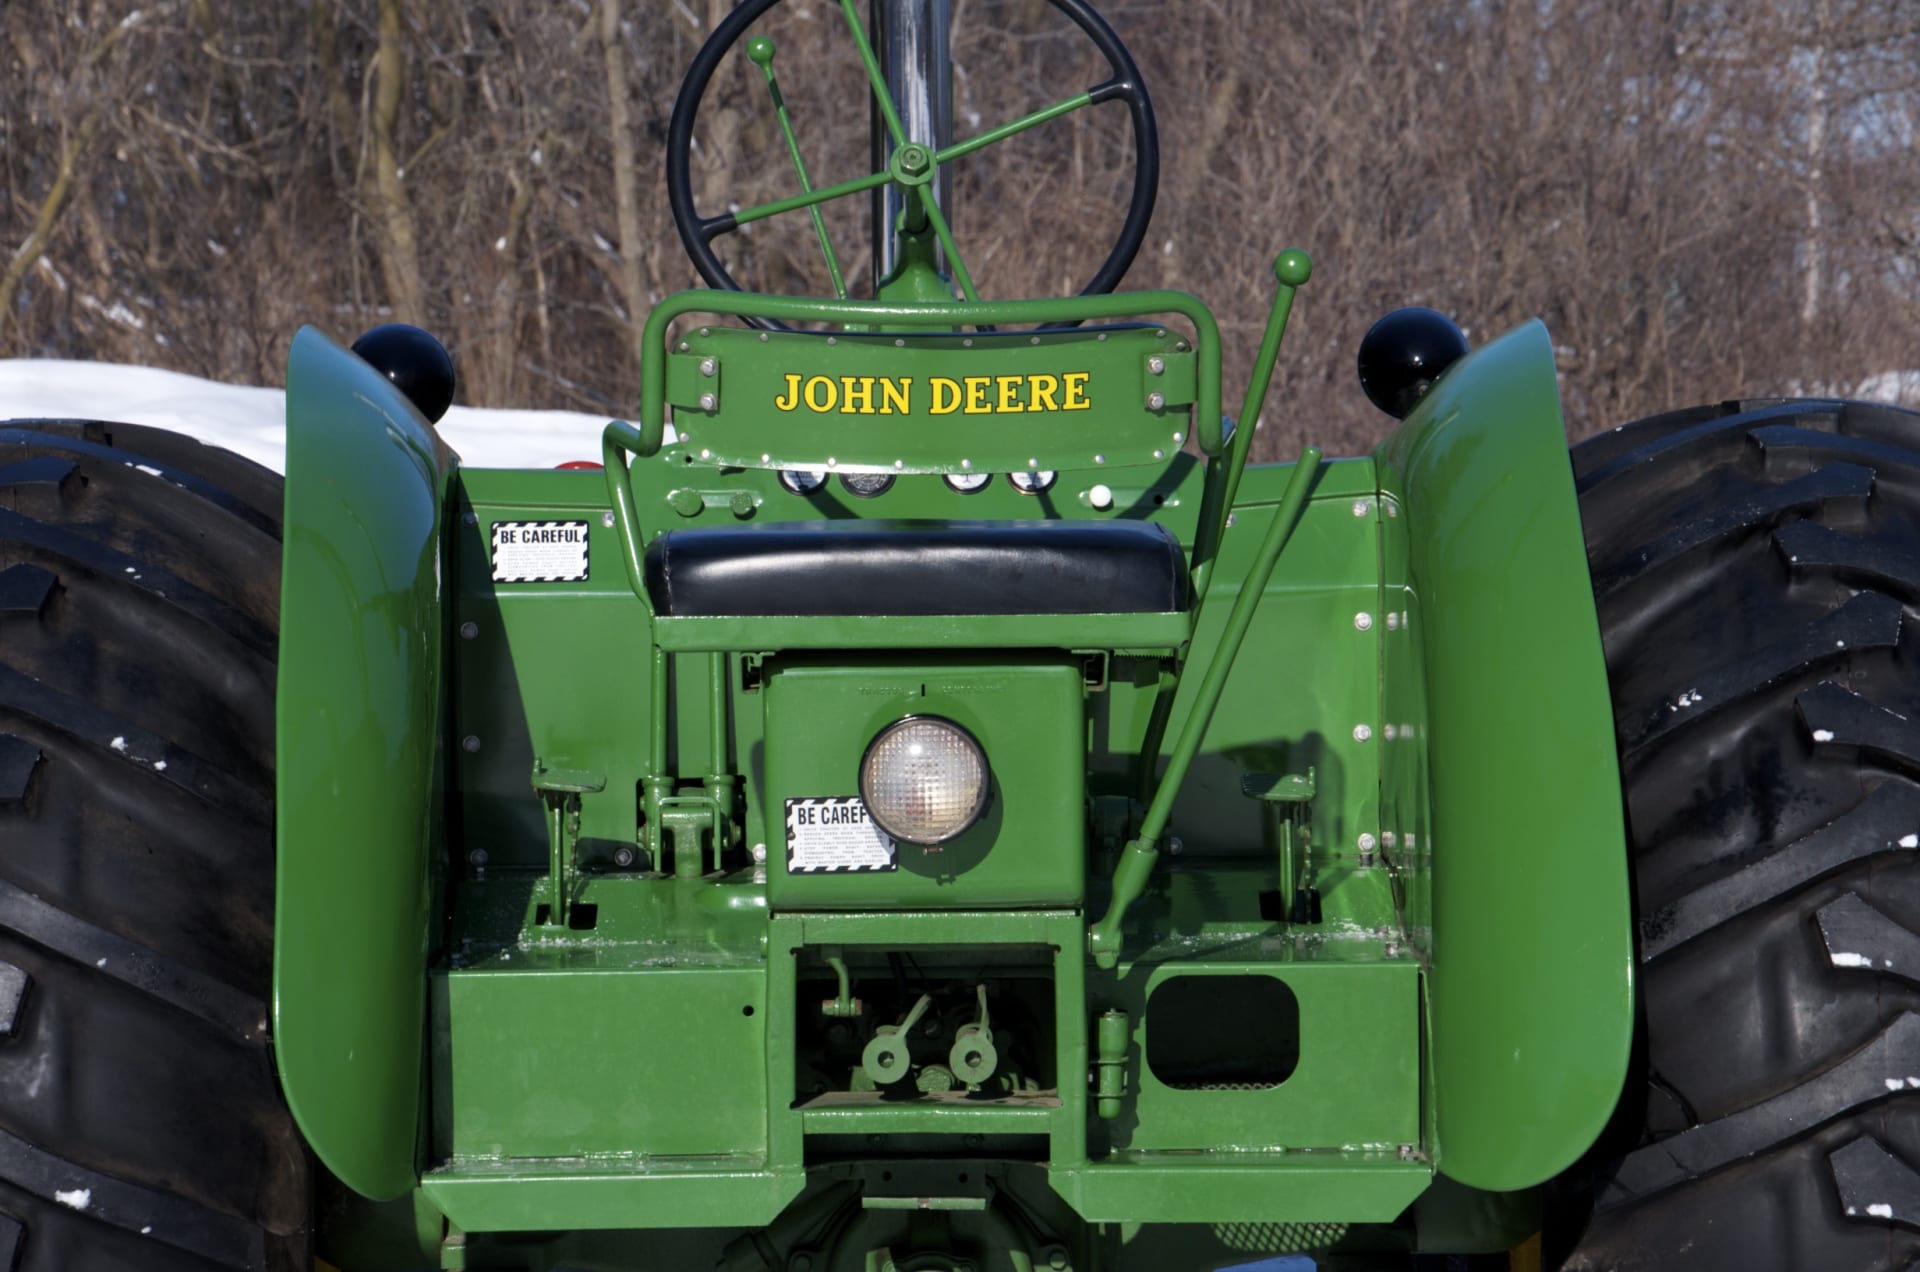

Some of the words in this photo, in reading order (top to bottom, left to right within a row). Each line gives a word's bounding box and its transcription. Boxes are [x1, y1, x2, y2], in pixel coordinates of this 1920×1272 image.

[775, 373, 914, 415] JOHN
[928, 371, 1092, 415] DEERE
[501, 530, 517, 544] BE
[522, 529, 581, 544] CAREFUL
[798, 807, 816, 825] BE
[821, 806, 869, 825] CAREF
